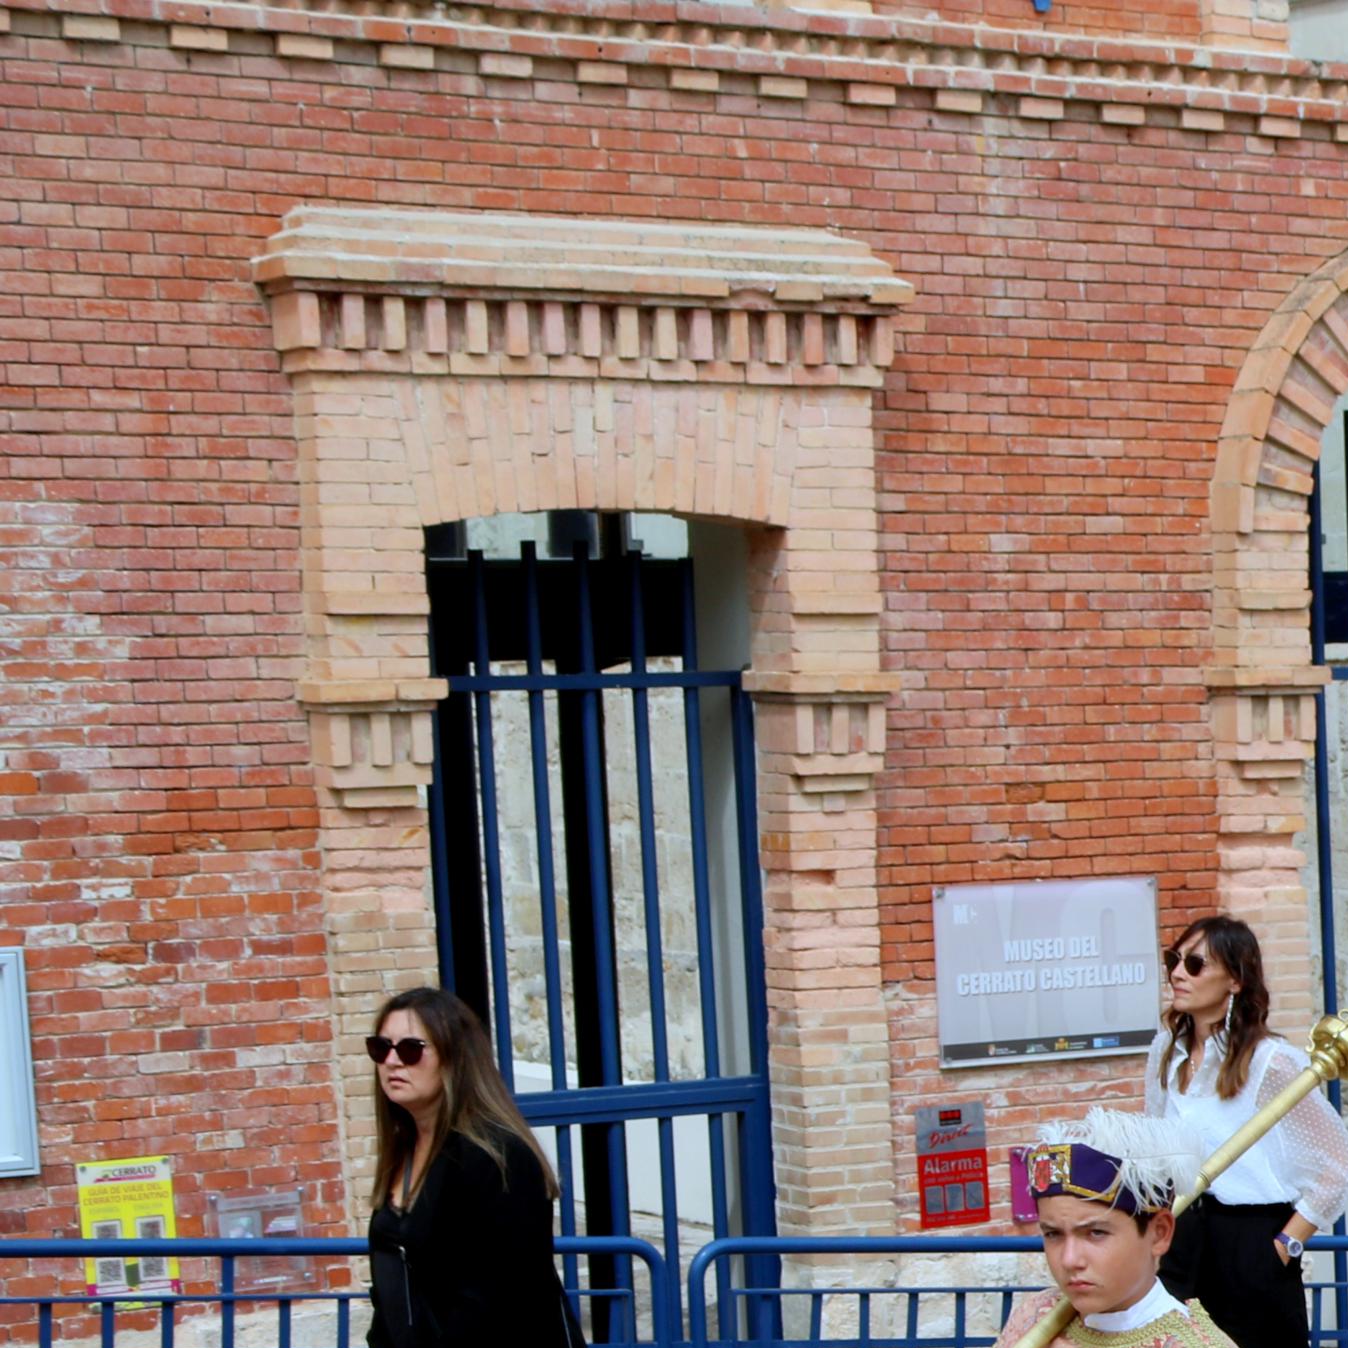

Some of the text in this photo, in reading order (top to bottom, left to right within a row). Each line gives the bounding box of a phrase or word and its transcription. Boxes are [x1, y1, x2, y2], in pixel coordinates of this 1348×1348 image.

[1003, 935, 1100, 963] MUSEO DEL
[957, 962, 1145, 997] CERRATO CASTELLANO
[111, 1165, 157, 1177] CERRATO
[923, 1156, 983, 1175] Alarma
[83, 1195, 121, 1207] CERRATO
